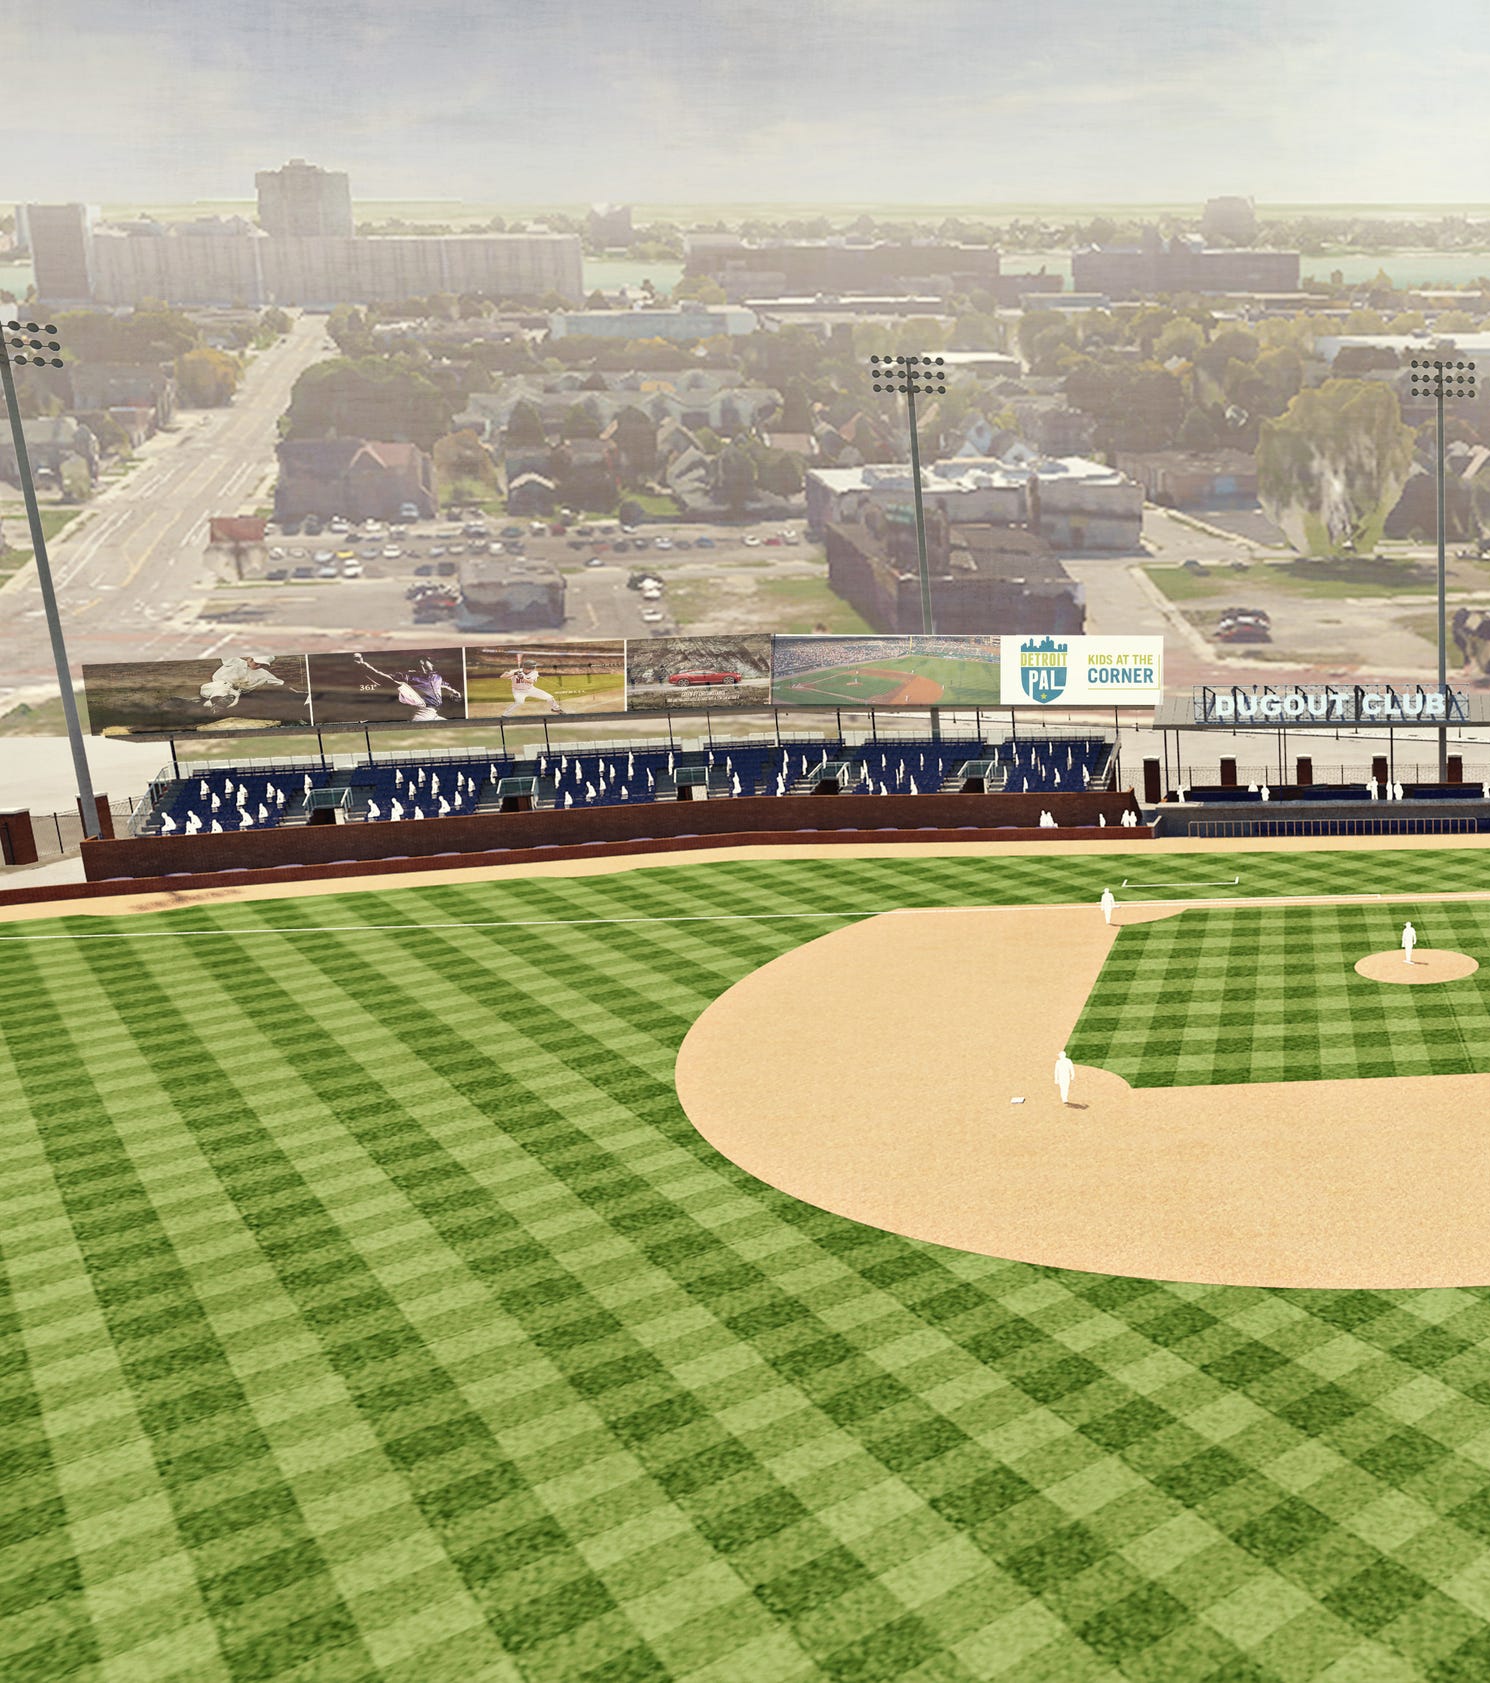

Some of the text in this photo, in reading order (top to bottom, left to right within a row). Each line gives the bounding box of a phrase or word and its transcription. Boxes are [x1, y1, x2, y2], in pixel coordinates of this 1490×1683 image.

[1020, 652, 1068, 667] DETROIT
[1087, 654, 1154, 665] KIDS AT THE
[1028, 669, 1065, 696] PAL
[1087, 668, 1154, 684] CORNER
[1214, 692, 1447, 716] DUGOUT CLUB
